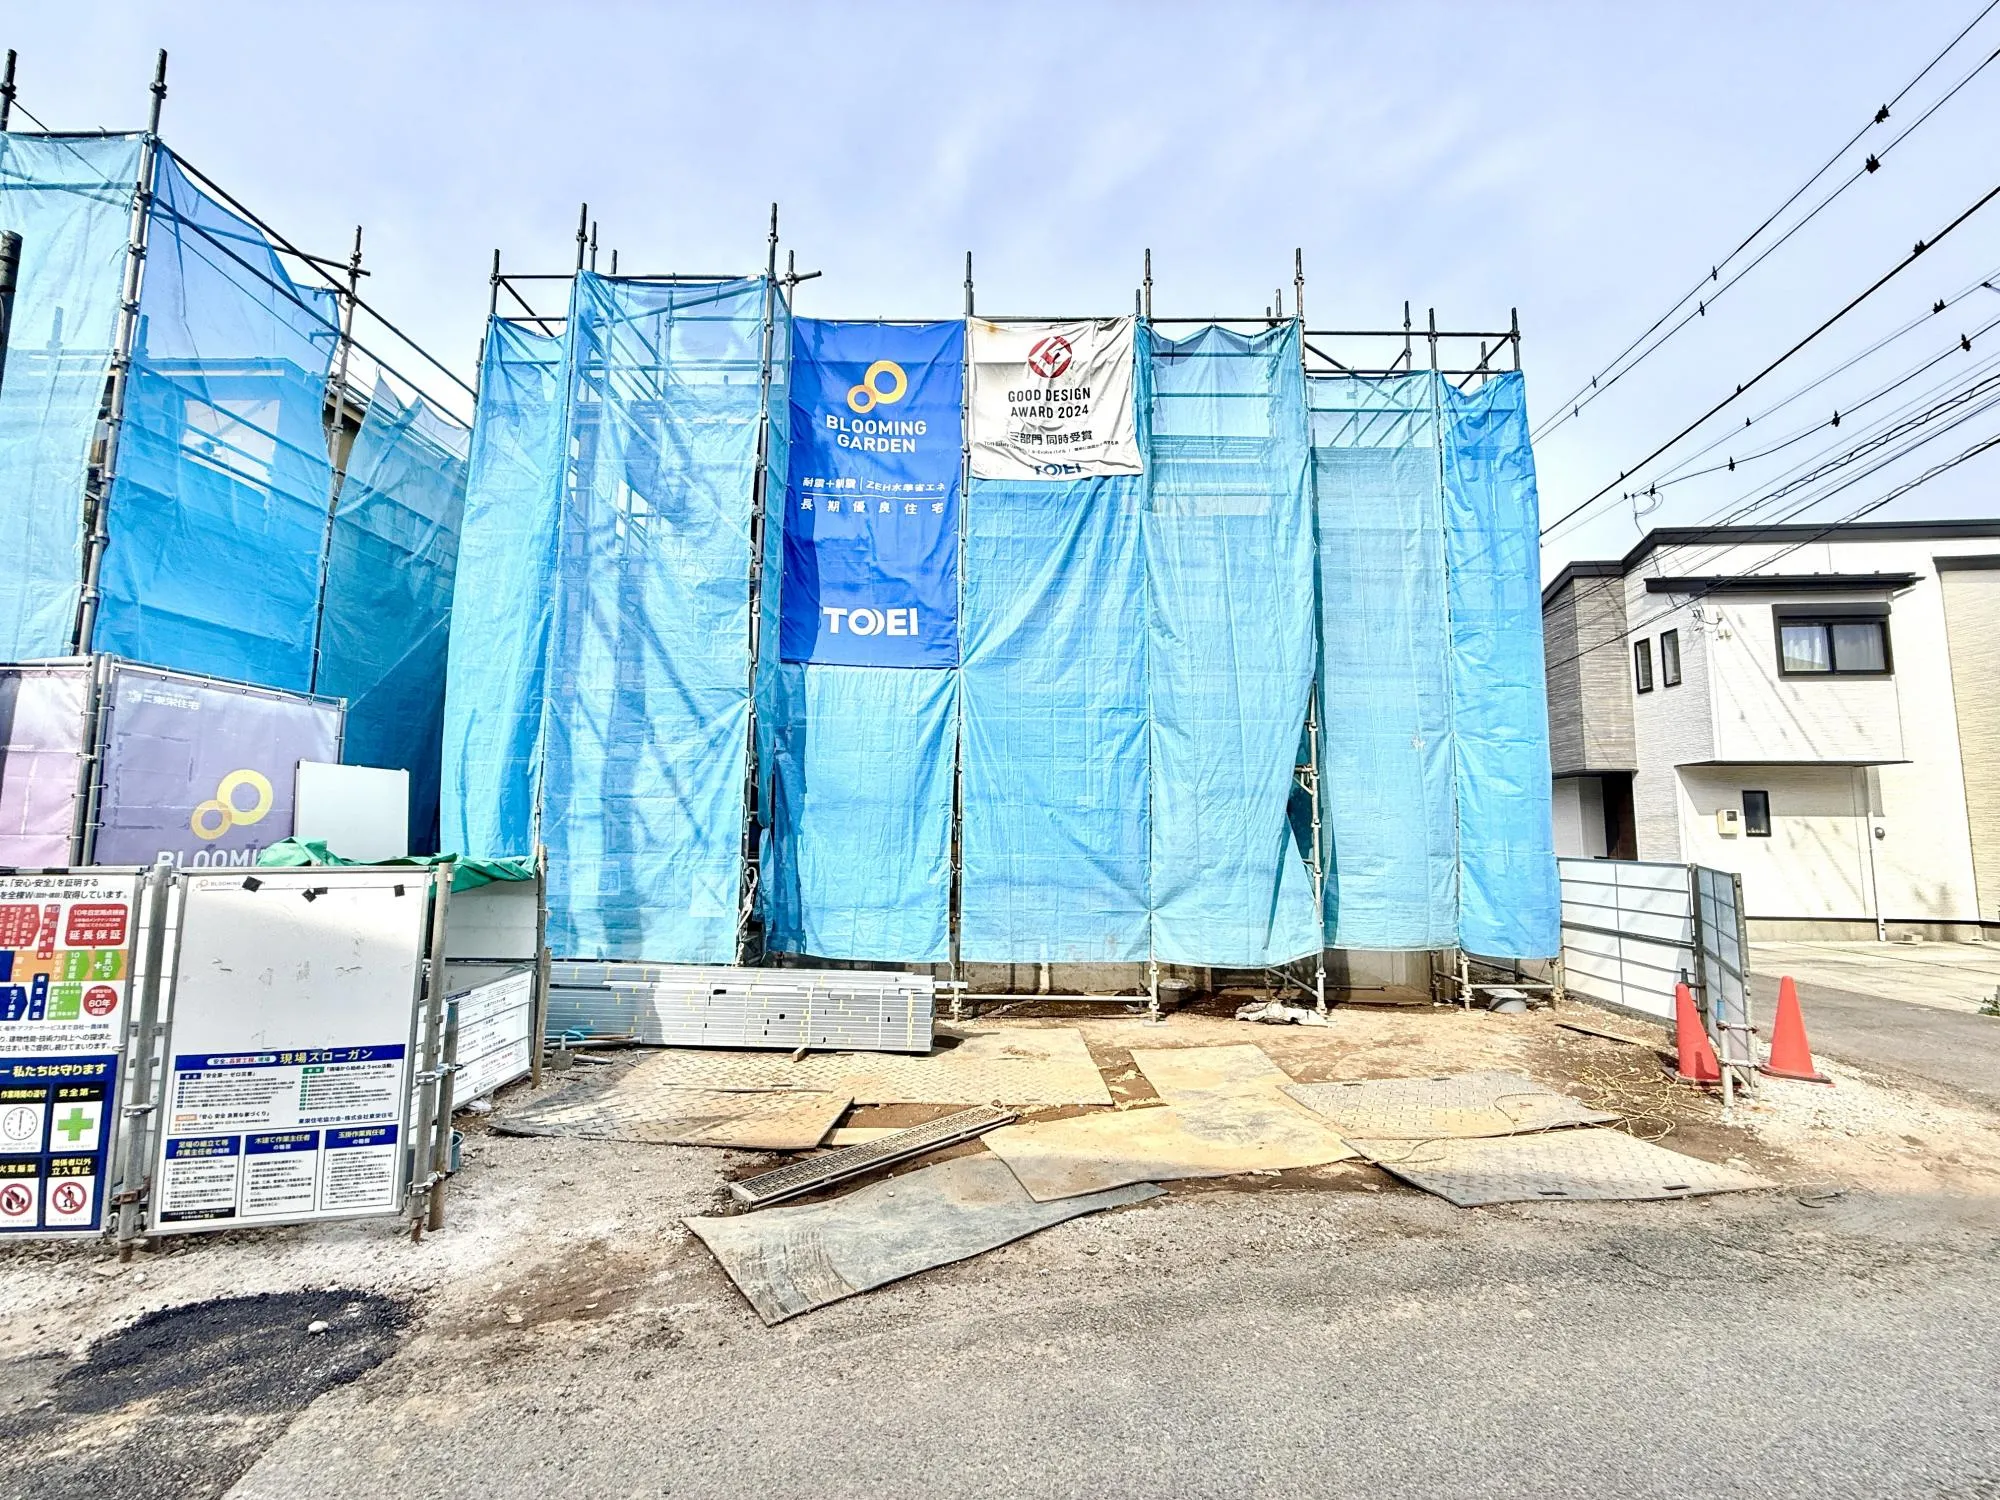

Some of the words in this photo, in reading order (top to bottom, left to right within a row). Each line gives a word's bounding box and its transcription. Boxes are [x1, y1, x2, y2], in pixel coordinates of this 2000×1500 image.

[1008, 389, 1041, 402] GOOD
[1045, 387, 1091, 402] DESIGN
[1010, 405, 1053, 418] AWARD
[1058, 404, 1089, 418] 2024
[826, 414, 927, 436] BLOOMING
[837, 434, 916, 453] GARDEN
[1009, 431, 1042, 445] 三部門
[1046, 430, 1093, 445] 同時受賞
[823, 606, 919, 636] TOEI
[69, 929, 121, 940] 延長保証
[88, 999, 111, 1008] 60年
[280, 1050, 373, 1065] 現場スローガン
[13, 1064, 107, 1077] 私たちは守ります
[59, 1088, 100, 1097] 安全第一
[52, 1157, 92, 1167] 関係者以外
[52, 1166, 91, 1176] 立入禁止
